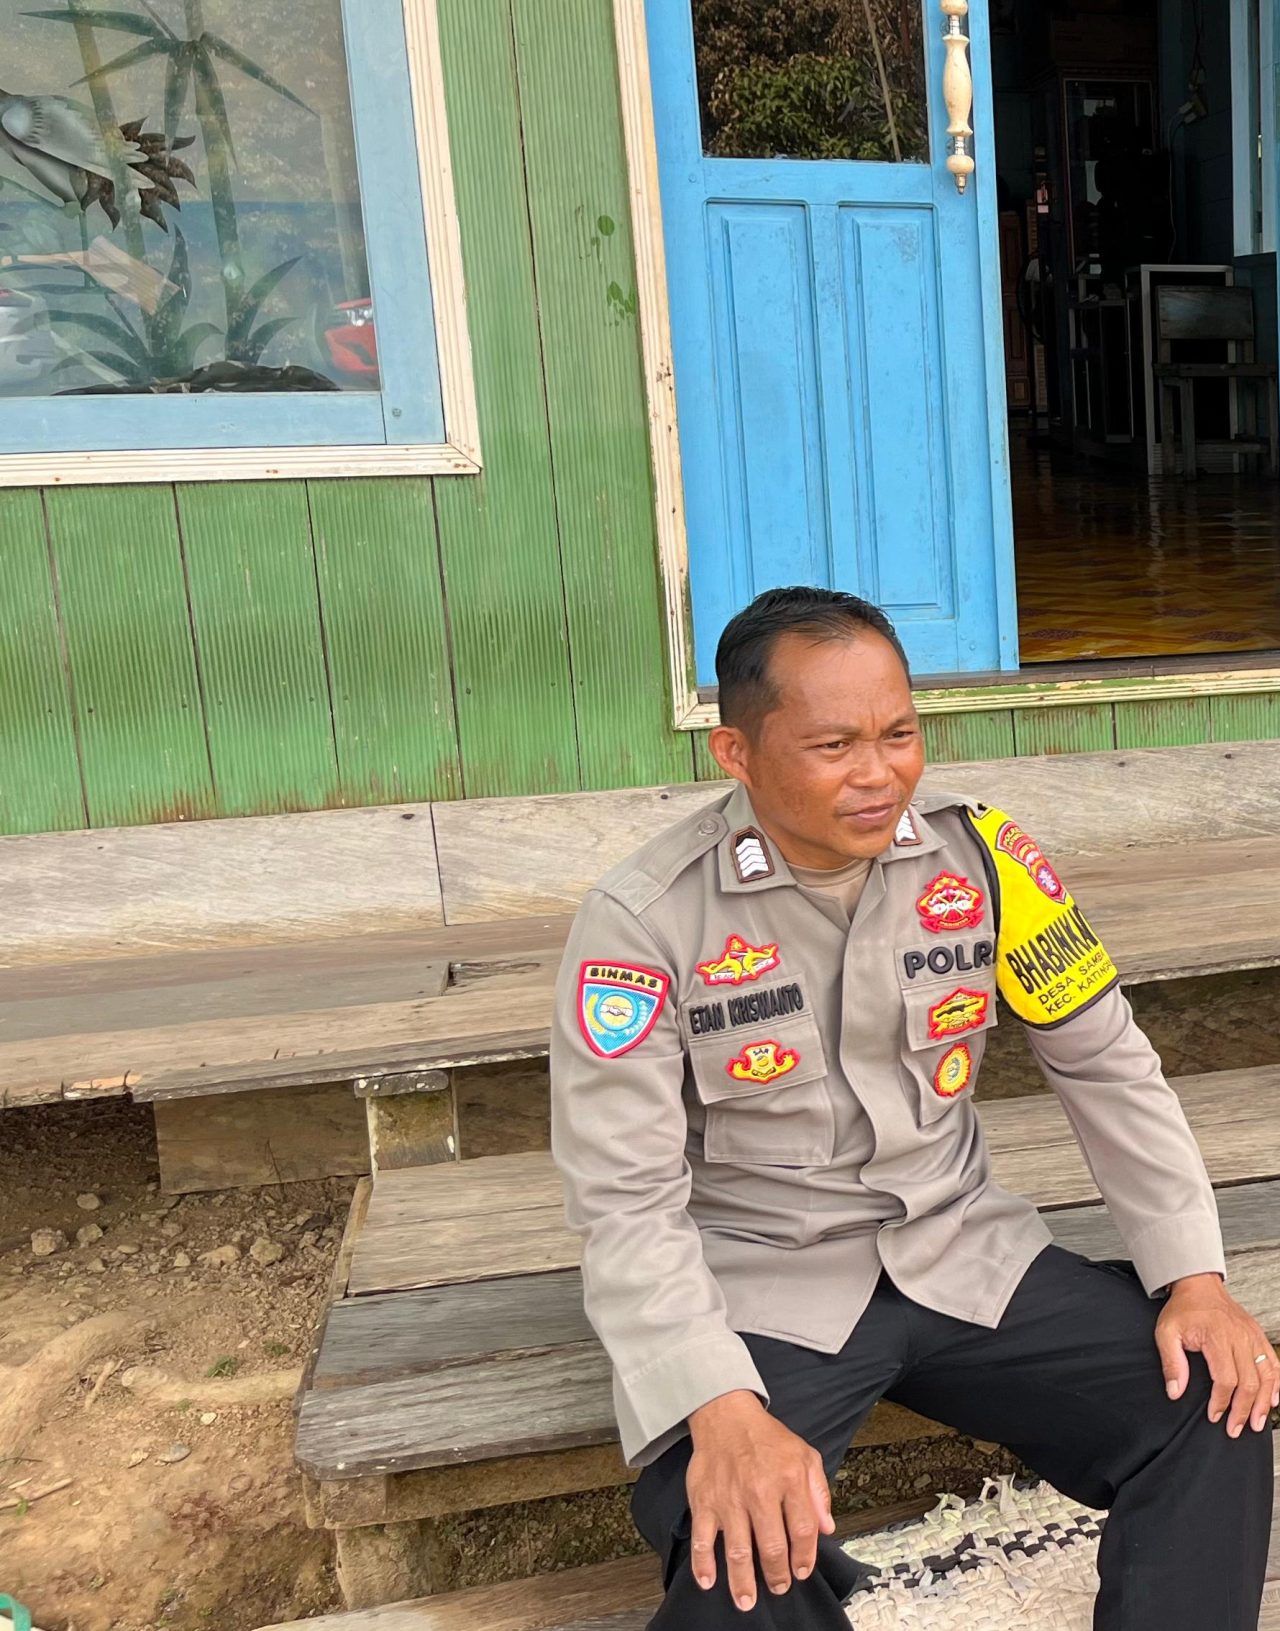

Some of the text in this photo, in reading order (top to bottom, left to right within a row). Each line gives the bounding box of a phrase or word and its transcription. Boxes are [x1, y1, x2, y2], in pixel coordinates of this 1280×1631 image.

[590, 967, 658, 988] BINMAS
[1038, 976, 1075, 1005] DESA
[688, 982, 804, 1035] ETAN KRISWANTO
